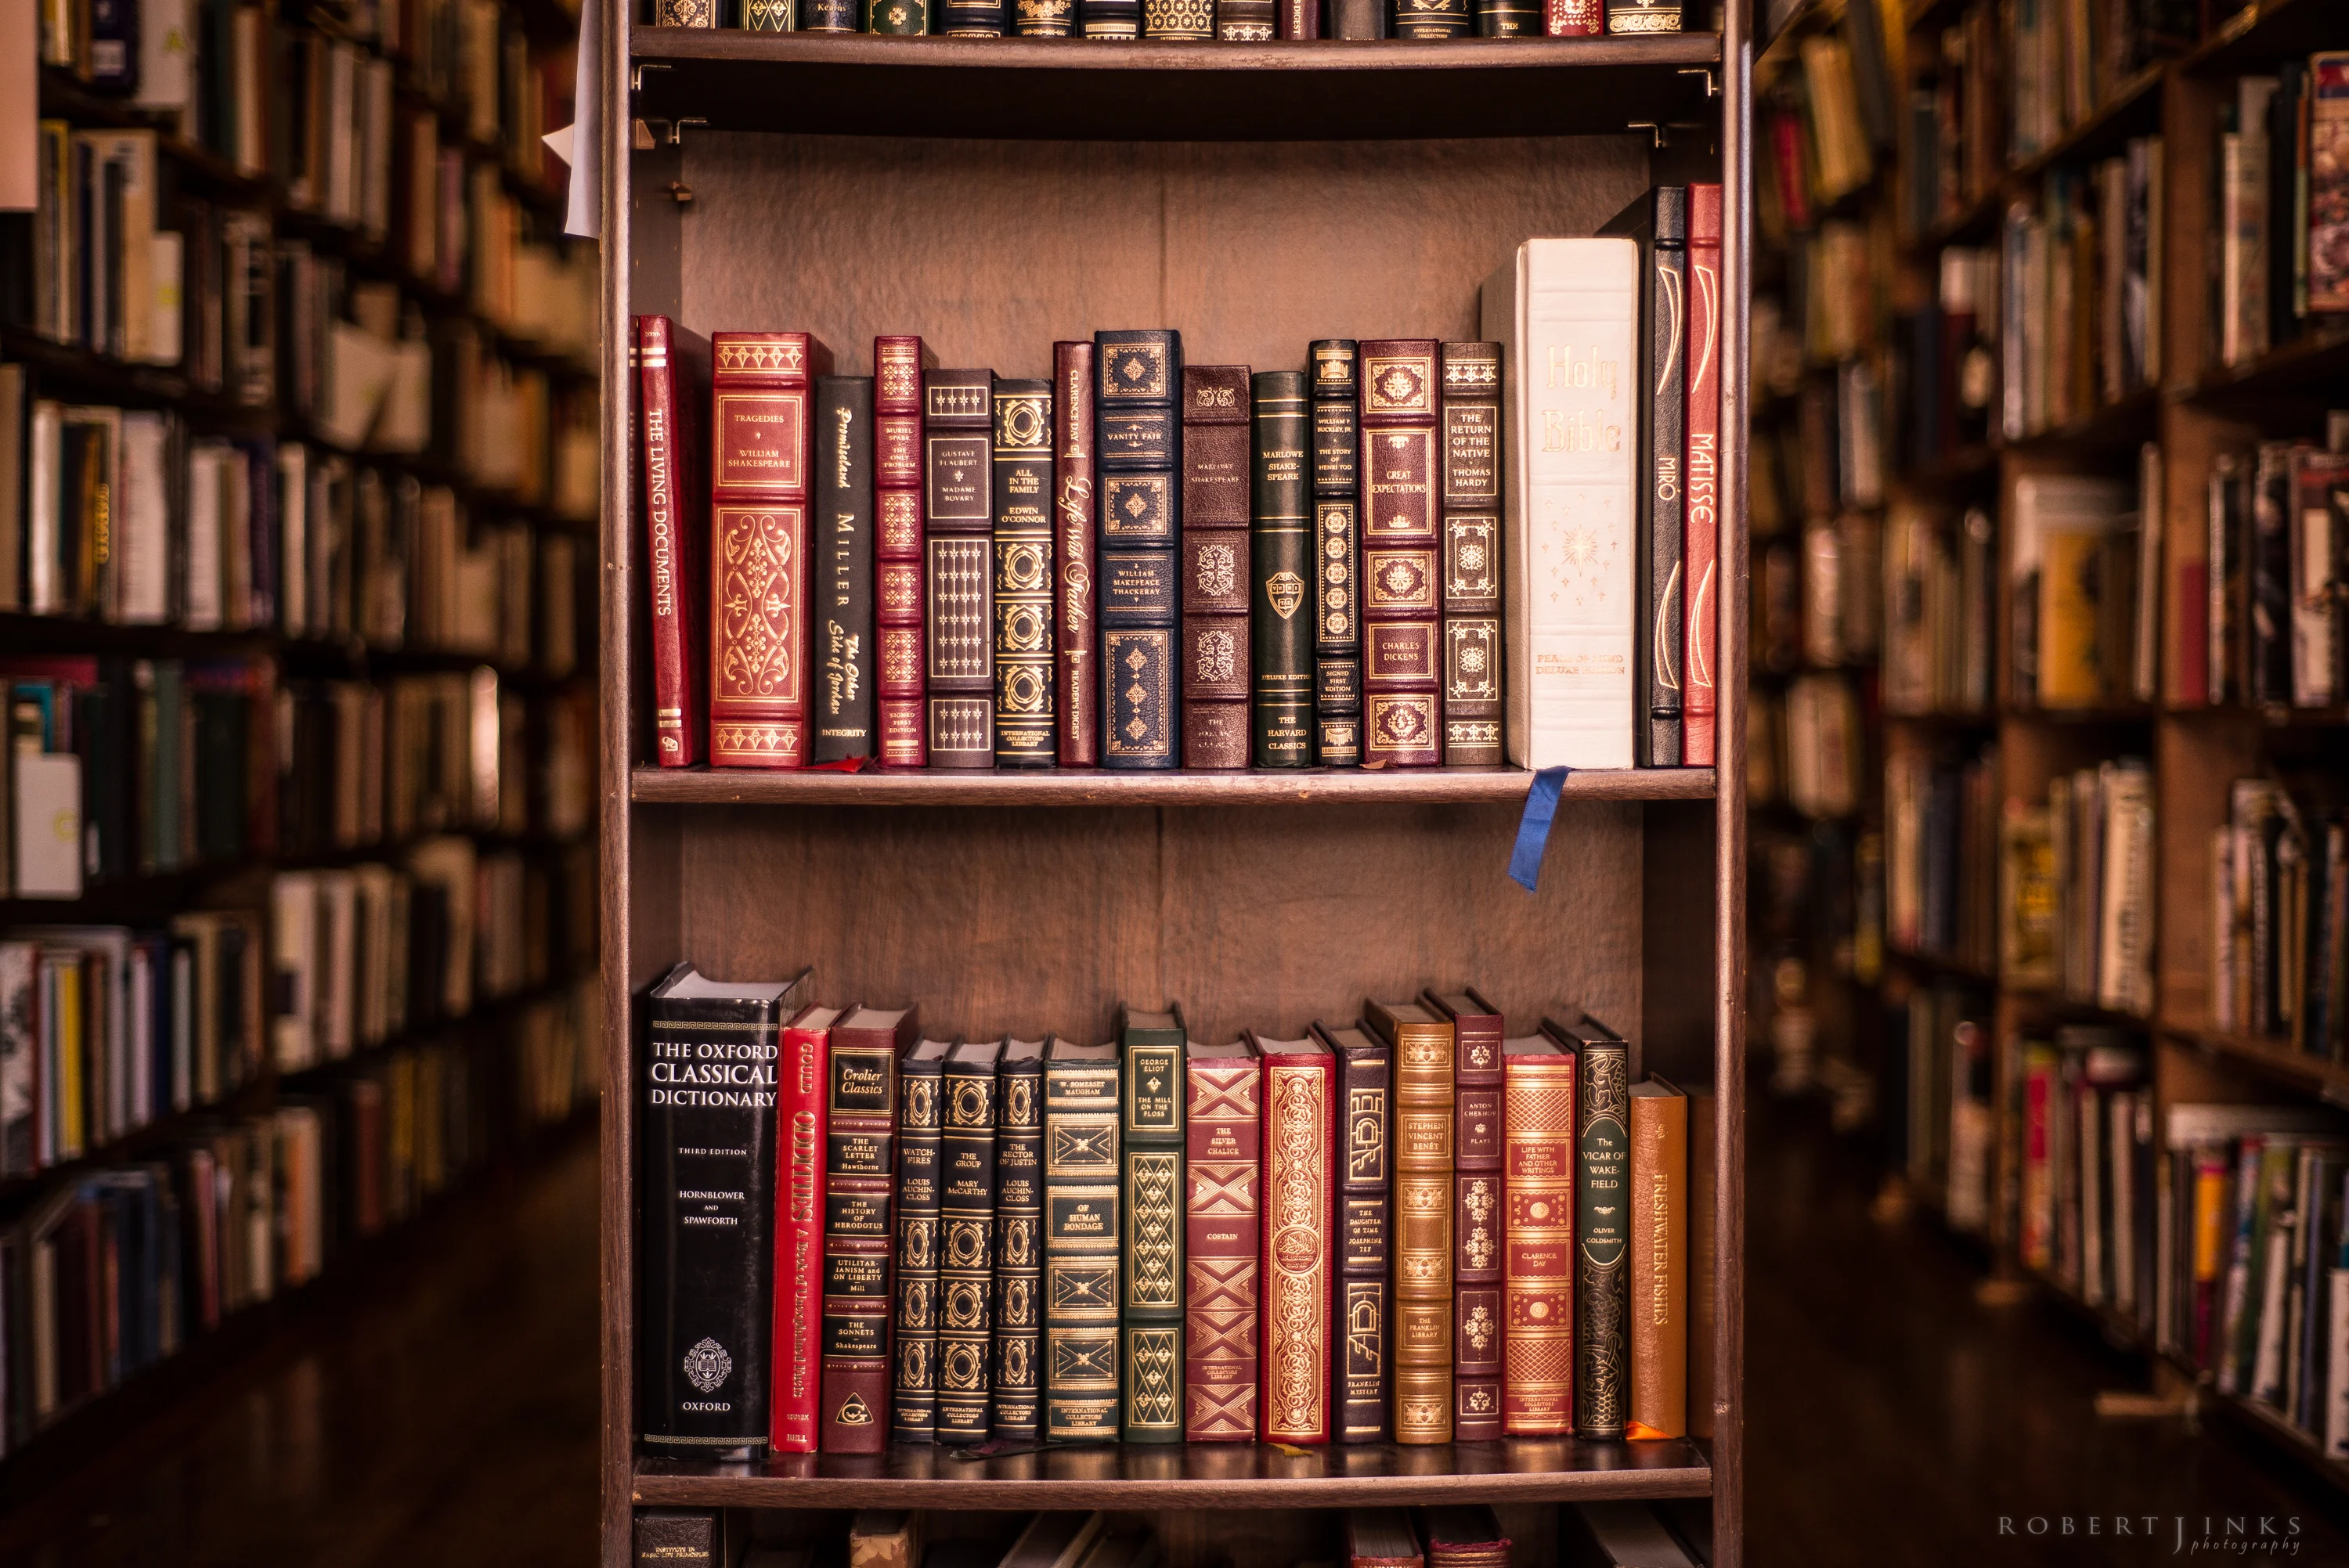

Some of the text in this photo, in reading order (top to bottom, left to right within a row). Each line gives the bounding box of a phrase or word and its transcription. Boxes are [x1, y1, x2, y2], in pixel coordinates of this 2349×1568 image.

[1293, 6, 1301, 34] DIGEST
[1546, 344, 1618, 400] Holy
[1070, 369, 1079, 442] CLARENCE DAY
[1451, 425, 1492, 434] RETURN
[1542, 409, 1621, 452] Bible
[728, 460, 791, 468] SHAKESPEARE
[1387, 471, 1411, 480] GREAT
[1690, 434, 1714, 524] MATISSE
[1373, 485, 1426, 493] EXPECTATIONS
[649, 409, 672, 616] THE LIVING DOCUMENTS
[838, 514, 855, 606] MILLER
[1058, 475, 1092, 633] Life Father
[827, 619, 845, 715] Side Jordan
[845, 662, 860, 701] Other
[822, 729, 867, 737] INTEGRITY
[1071, 711, 1080, 741] DIGEST
[653, 1042, 778, 1059] THE OXFORD
[651, 1062, 778, 1084] CLASSICAL
[800, 1042, 814, 1094] GOULD
[843, 1069, 882, 1081] Grolier
[842, 1081, 883, 1094] Classics
[651, 1089, 777, 1106] DICTIONARY
[1413, 1141, 1439, 1150] BENÉT
[1582, 1152, 1626, 1160] VICAR OF
[791, 1110, 816, 1221] ODDITIES
[1589, 1166, 1620, 1174] WAKE-
[1591, 1180, 1618, 1188] FIELD
[680, 1191, 745, 1199] HORNBLOWER
[684, 1216, 738, 1225] SPAWFORTH
[1063, 1222, 1104, 1231] BONDAGE
[1654, 1173, 1669, 1325] FRESHWATER FISHES
[792, 1241, 809, 1397] Book Unexplained Facts
[683, 1401, 731, 1411] OXFORD
